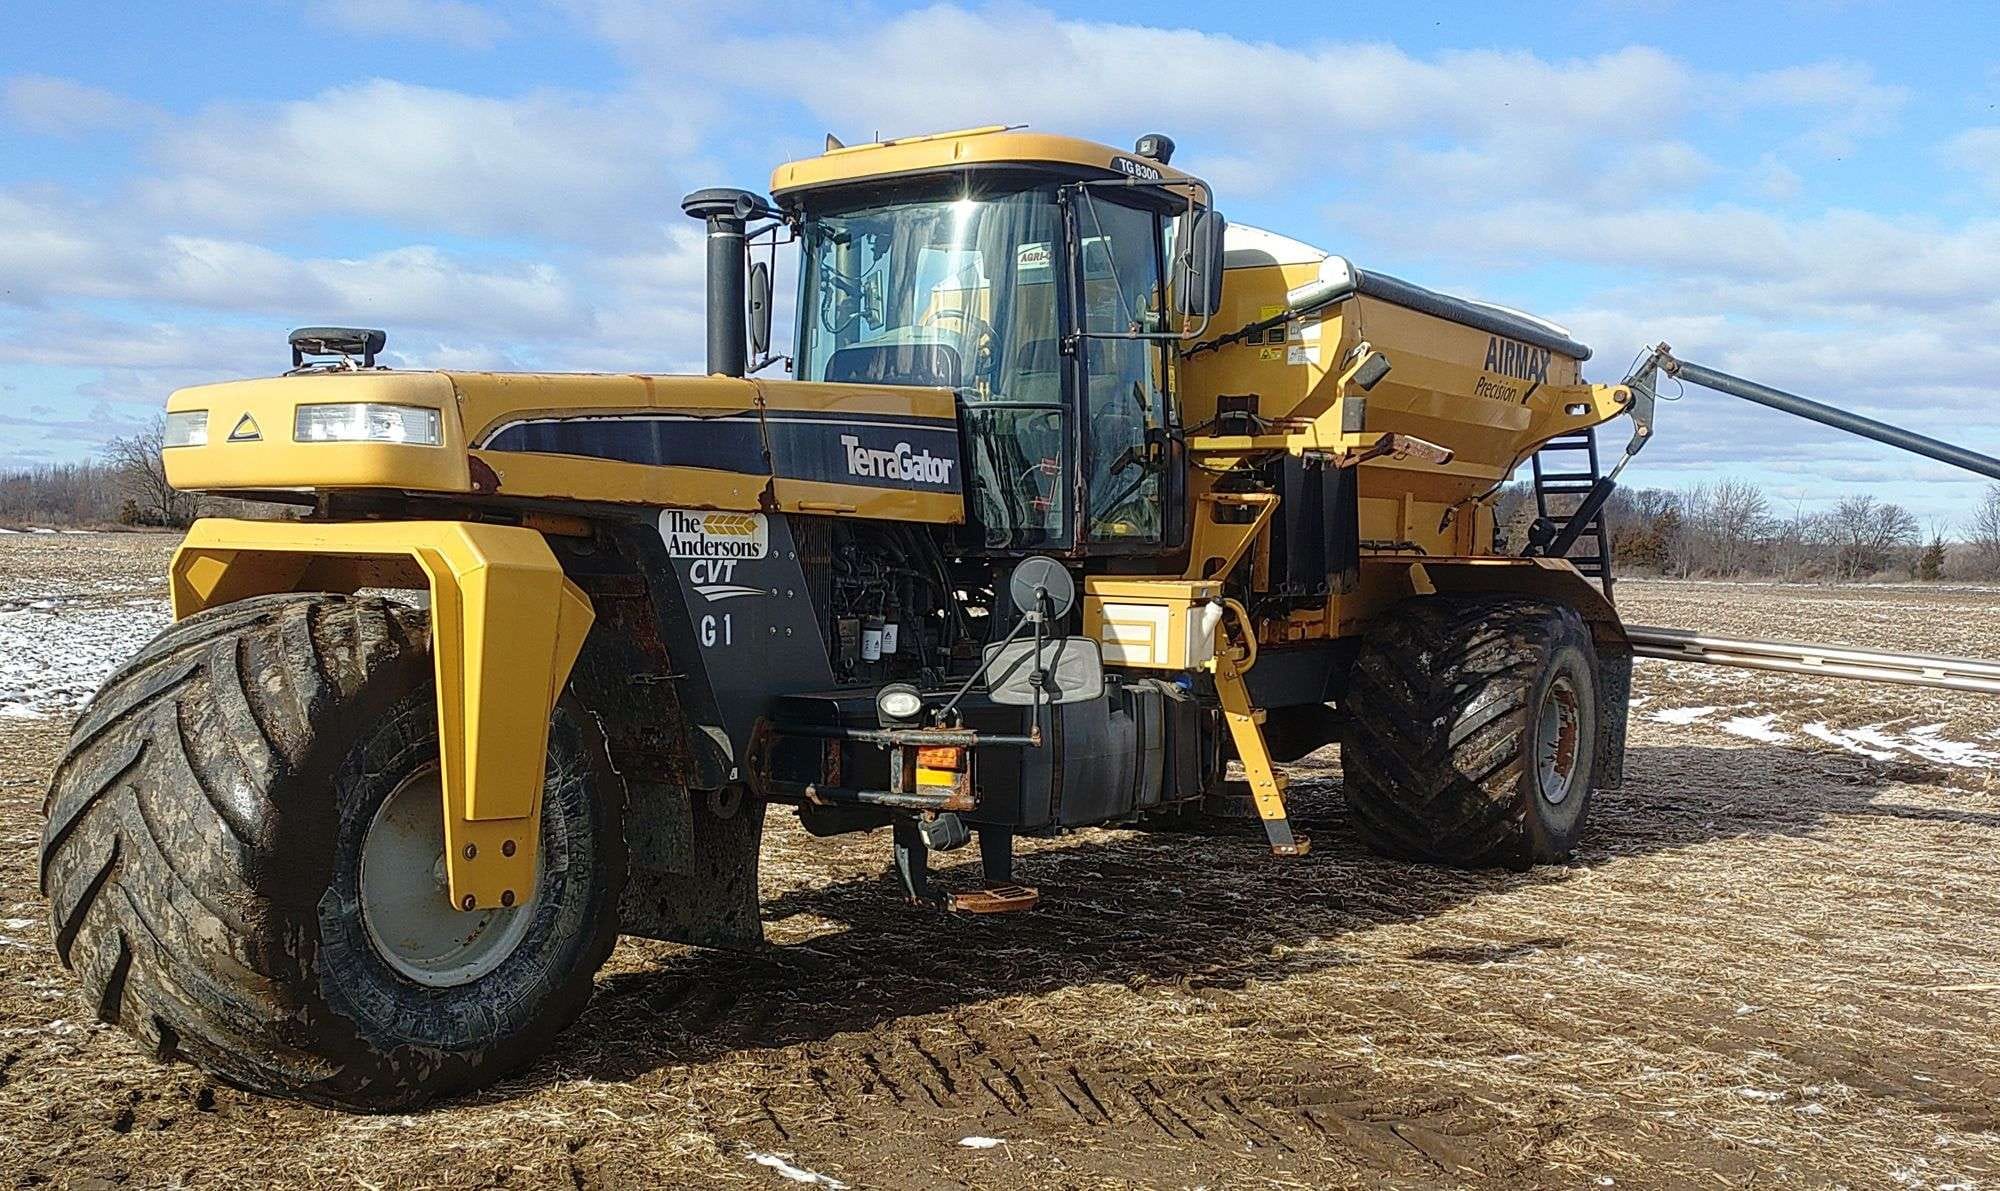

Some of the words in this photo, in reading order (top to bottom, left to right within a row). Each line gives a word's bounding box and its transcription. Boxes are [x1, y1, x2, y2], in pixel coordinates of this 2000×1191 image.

[1119, 158, 1134, 174] TG
[1135, 163, 1159, 180] 8300
[1484, 336, 1551, 390] AIRMAX
[1474, 376, 1518, 403] Precision
[840, 434, 953, 485] TerraGator
[668, 510, 701, 534] The
[668, 532, 760, 558] Andersons
[689, 559, 738, 584] CVT
